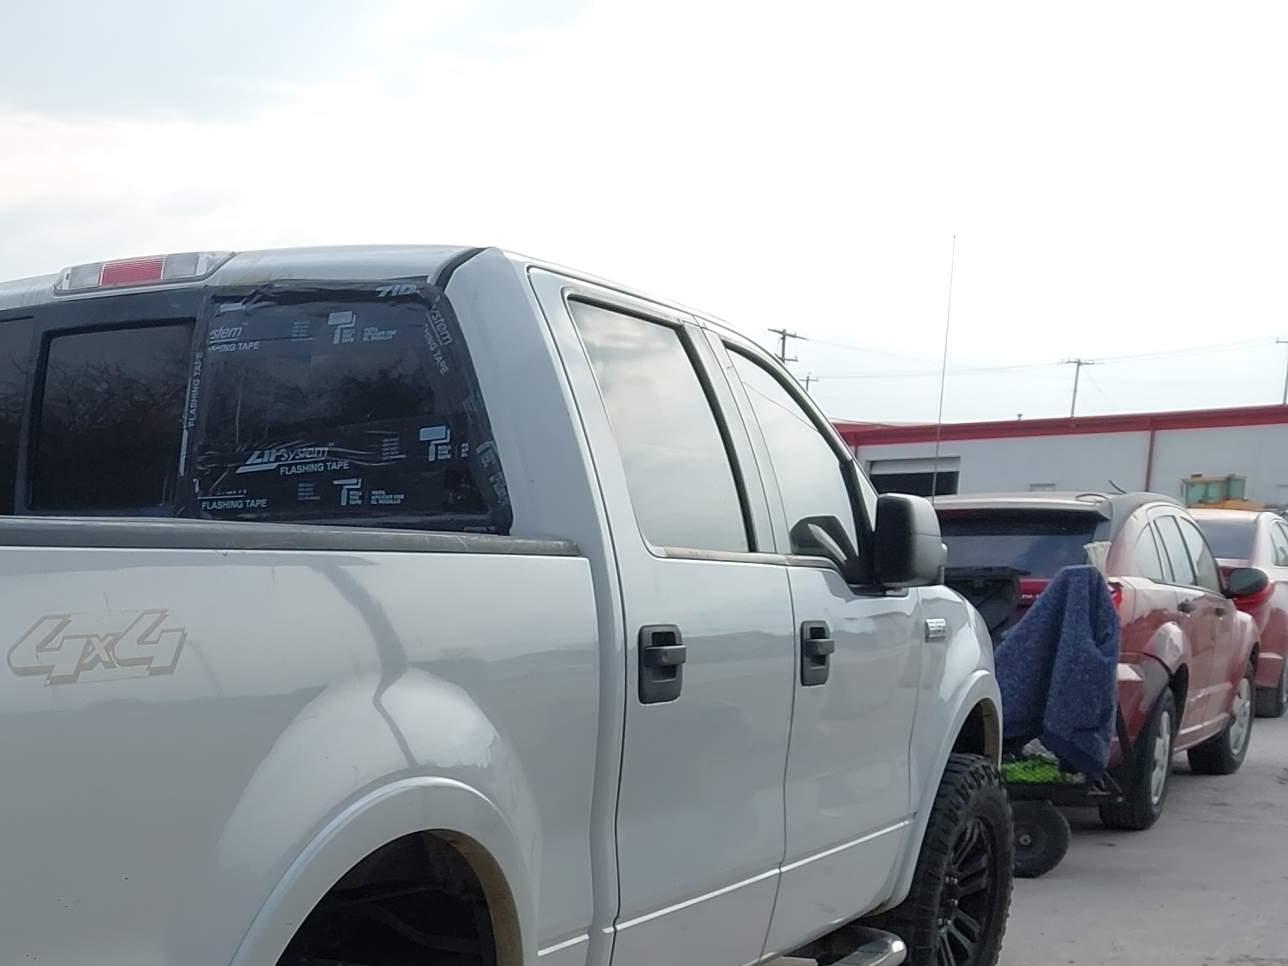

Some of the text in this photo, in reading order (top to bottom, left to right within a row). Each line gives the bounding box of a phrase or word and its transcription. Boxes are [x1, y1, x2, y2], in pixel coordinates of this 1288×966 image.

[280, 460, 350, 476] FLASHING TAPE
[201, 498, 268, 511] FLASHING TAPE
[7, 608, 187, 686] 4x4
